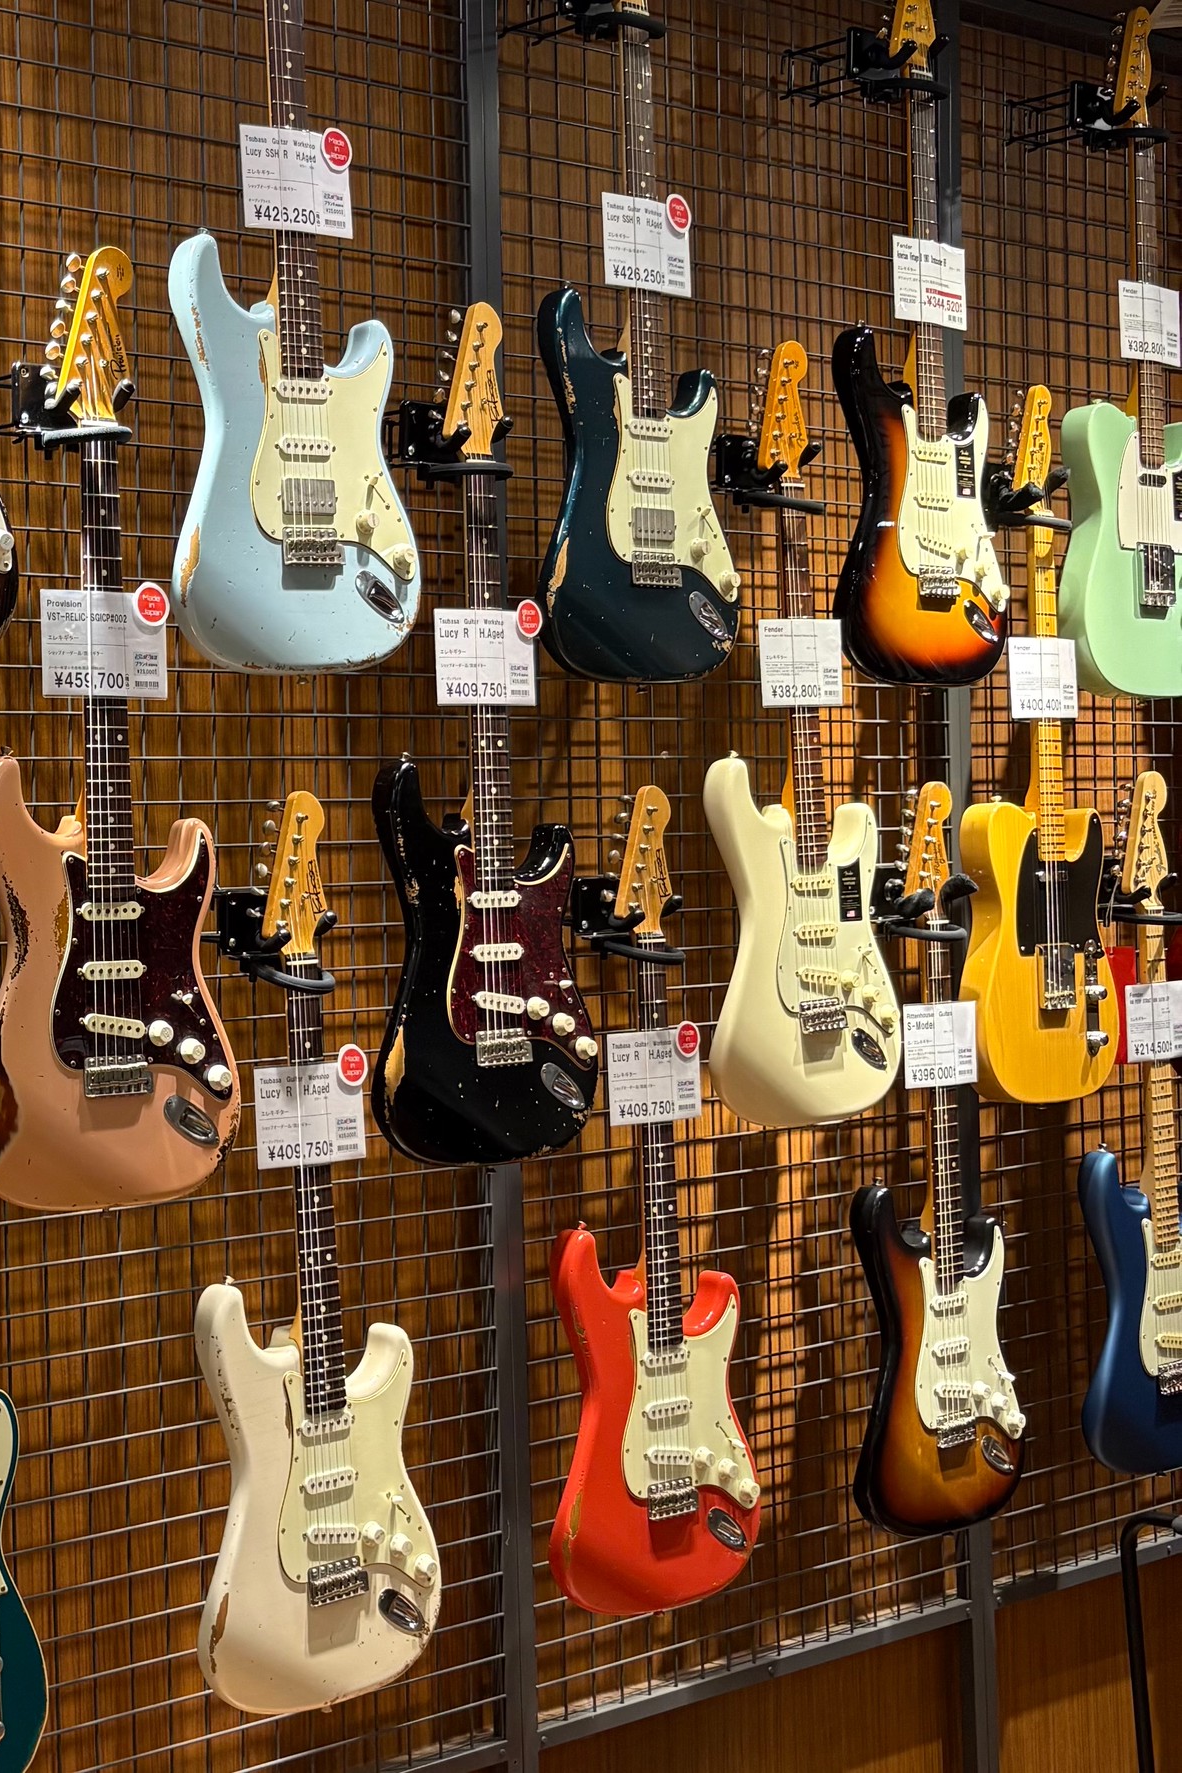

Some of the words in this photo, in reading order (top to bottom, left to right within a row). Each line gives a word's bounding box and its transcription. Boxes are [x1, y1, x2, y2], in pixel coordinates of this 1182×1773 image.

[293, 139, 316, 150] Workshop
[245, 146, 262, 158] Lucy
[265, 148, 280, 159] SSH
[283, 149, 289, 160] R
[295, 151, 317, 163] H.Aged
[254, 204, 316, 225] ¥426,250
[606, 212, 620, 223] Lucy
[622, 214, 634, 224] SSH
[612, 264, 662, 285] ¥426,250
[110, 334, 126, 380] Provision
[46, 599, 82, 608] Provision
[142, 594, 161, 603] Made
[46, 612, 128, 624] VST-RELIC-SGICP#002
[142, 608, 163, 617] Japan
[439, 627, 459, 639] Lucy
[463, 628, 469, 639] R
[479, 628, 505, 640] H.Aged
[446, 682, 503, 698] ¥409,750
[771, 684, 818, 699] ¥382,800
[907, 1020, 935, 1031] S-Model
[612, 1052, 630, 1063] Lucy
[634, 1050, 640, 1061] R
[649, 1048, 672, 1060] H.Aged
[1134, 1040, 1170, 1056] ¥214,500
[308, 1073, 330, 1081] Workshop
[344, 1069, 362, 1077] Japan
[912, 1066, 953, 1083] ¥396000
[260, 1087, 281, 1099] Lucy
[286, 1086, 292, 1098] R
[303, 1082, 330, 1096] H.Aged
[618, 1100, 671, 1118] ¥409,750
[267, 1140, 329, 1161] ¥409,750
